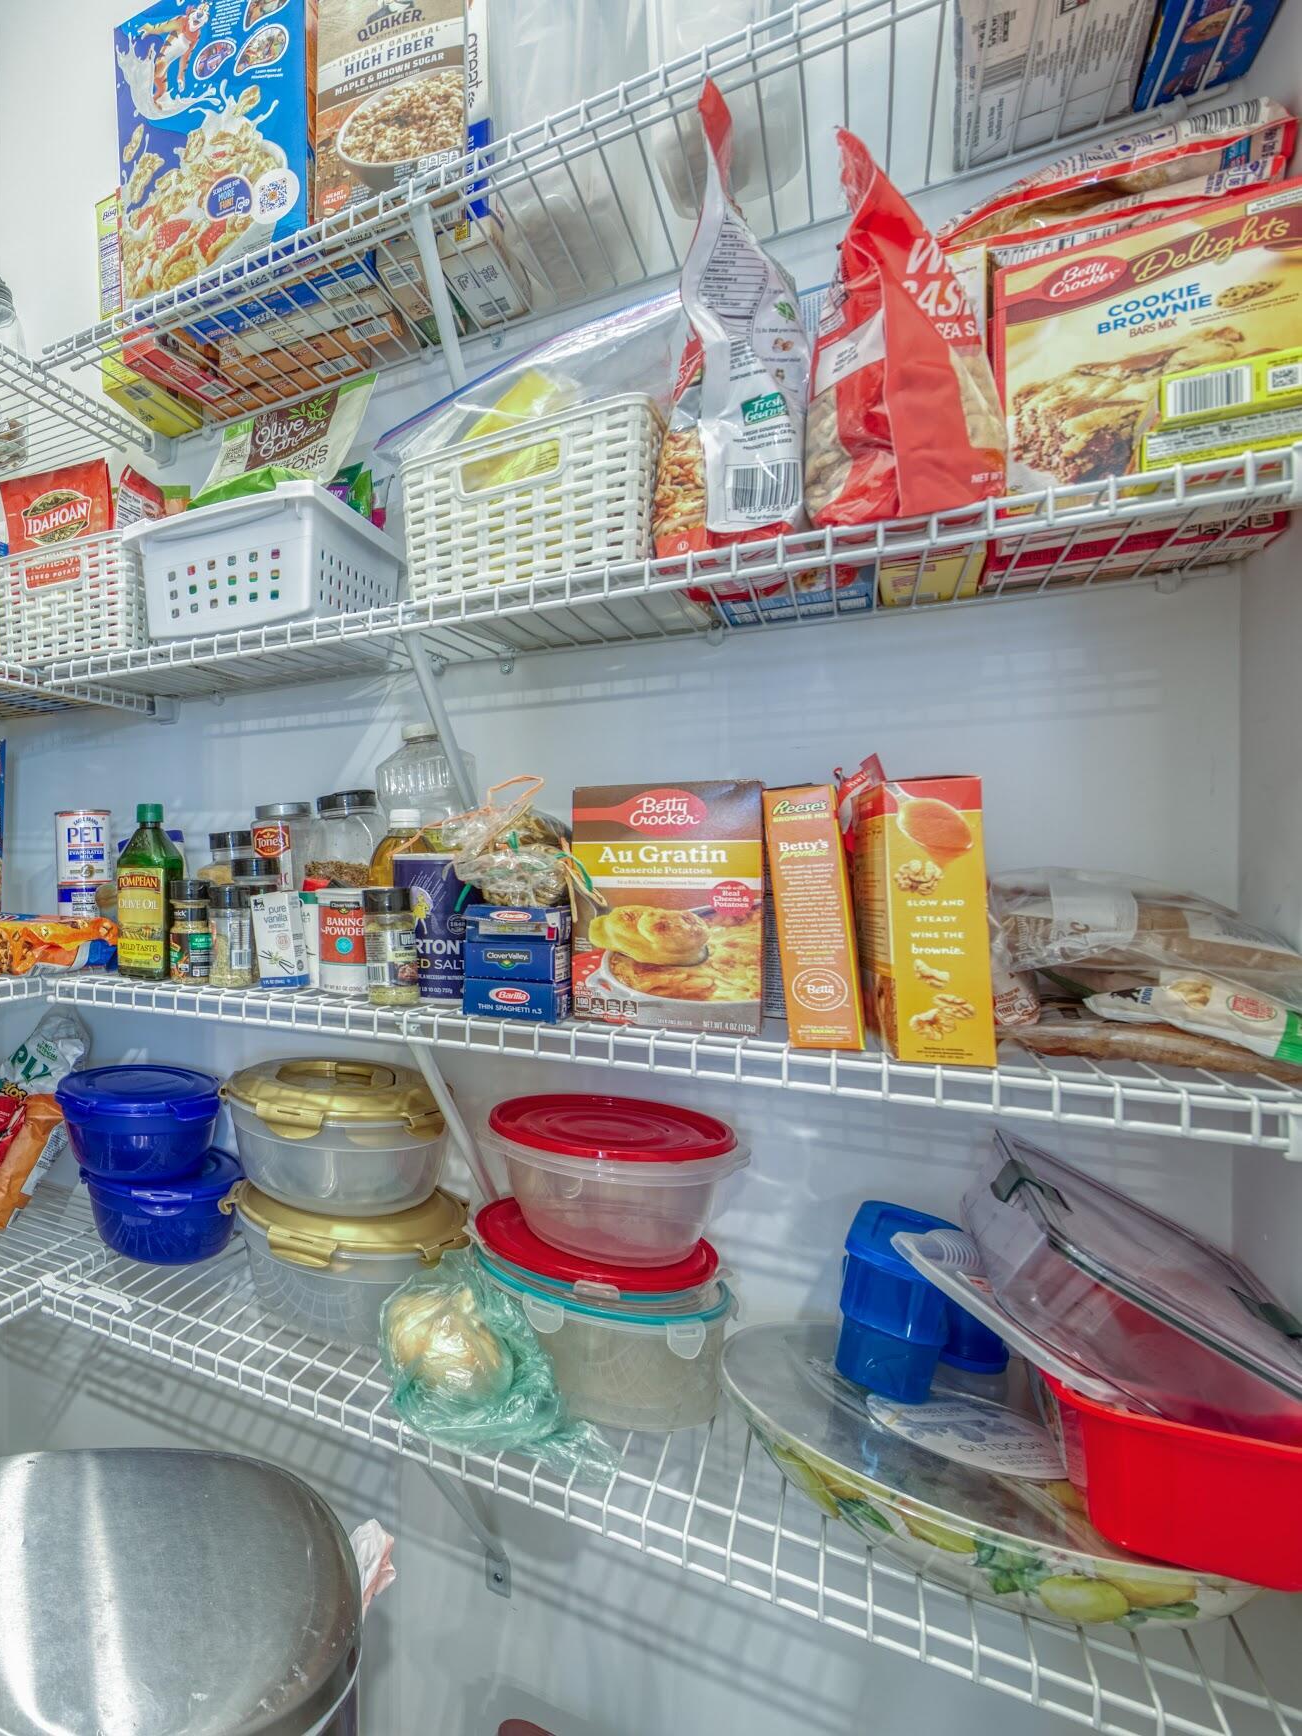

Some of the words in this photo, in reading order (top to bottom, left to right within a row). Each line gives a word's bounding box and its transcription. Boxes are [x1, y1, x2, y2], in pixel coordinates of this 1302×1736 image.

[345, 50, 382, 77] HIGH
[387, 35, 435, 60] FIBER
[335, 76, 369, 96] MAPLE
[371, 74, 381, 85] &
[383, 61, 413, 82] BROWN
[415, 52, 445, 71] SUGAR
[218, 189, 235, 201] MORE
[323, 193, 347, 207] HEALTHY
[325, 188, 345, 199] HEART
[1132, 216, 1290, 284] Delights
[1063, 261, 1107, 282] Betty
[1049, 270, 1115, 298] Crocker
[1107, 283, 1201, 318] COOKIE
[1097, 294, 1213, 335] BROWNIE
[1129, 323, 1156, 339] BARS
[1158, 317, 1178, 329] MIX
[752, 395, 784, 412] Fresh
[256, 418, 304, 445] Olive
[259, 420, 326, 458] Garden
[28, 502, 88, 535] IDAHOAN
[636, 797, 689, 816] Betty
[772, 800, 827, 815] Reese's
[629, 810, 700, 827] Crocker
[67, 827, 103, 844] PET
[256, 836, 285, 848] Tone's
[779, 838, 829, 852] Betty's
[598, 846, 633, 863] Au
[638, 845, 728, 863] Gratin
[779, 849, 828, 862] promise
[612, 866, 663, 874] Casserole
[664, 866, 713, 874] Potatoes
[118, 875, 158, 888] POMPEIAN
[713, 895, 741, 903] Cheese
[721, 890, 740, 898] Real
[118, 899, 140, 910] OLIVE
[142, 899, 158, 910] OIL
[268, 905, 286, 914] pure
[713, 901, 749, 909] Potatoes
[263, 914, 288, 923] vanilla
[326, 917, 364, 926] BAKING
[911, 931, 941, 939] WINS
[944, 931, 964, 939] THE
[120, 943, 135, 952] MILD
[136, 943, 157, 953] TASTE
[497, 991, 527, 1001] Barilla
[807, 983, 834, 996] Betty
[958, 1442, 1045, 1452] OUTDOOR
